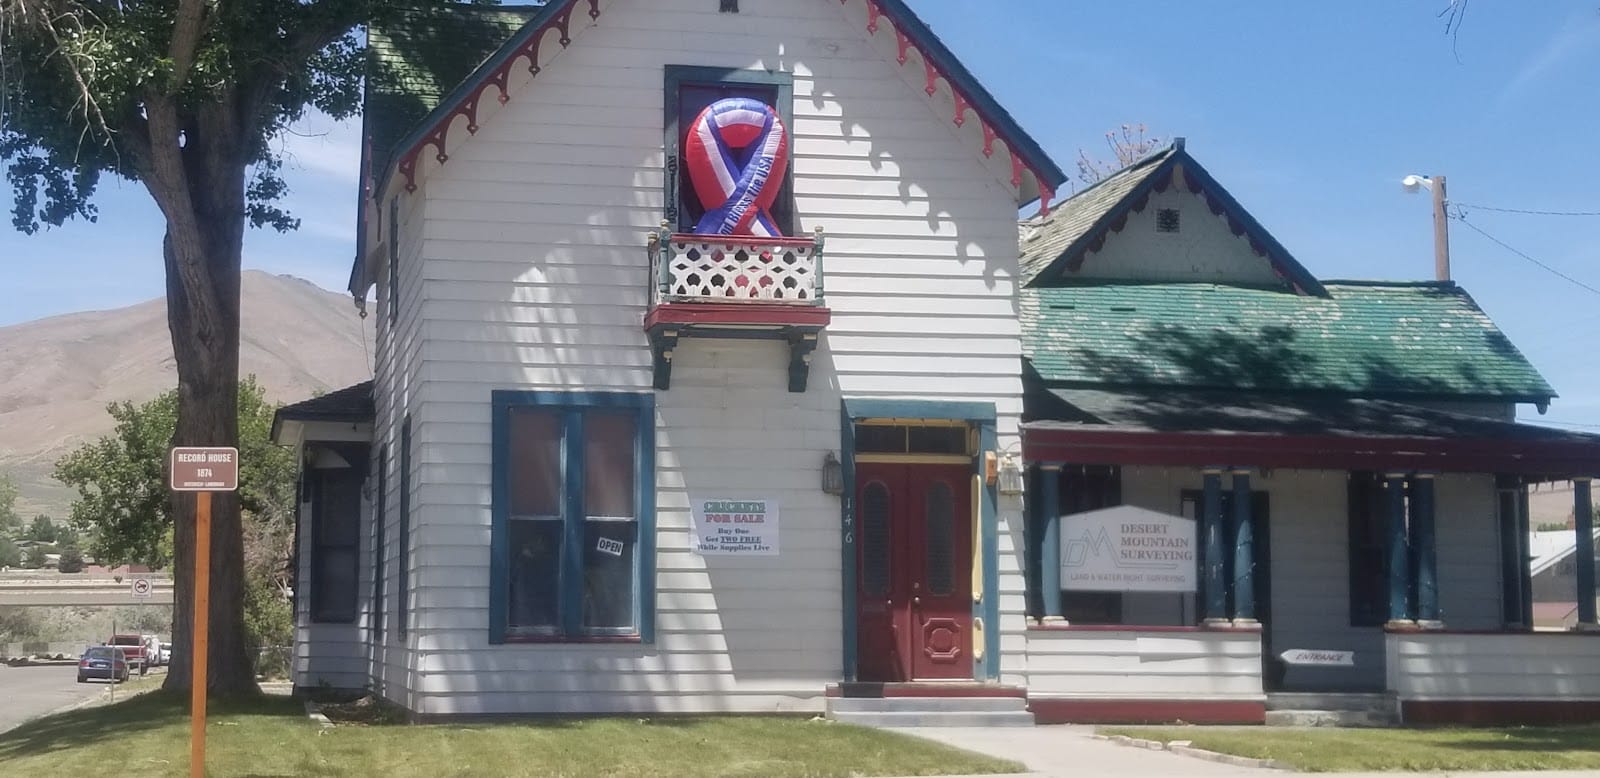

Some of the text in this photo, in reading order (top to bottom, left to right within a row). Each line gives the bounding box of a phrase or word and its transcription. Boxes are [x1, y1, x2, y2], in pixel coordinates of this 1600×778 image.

[726, 197, 753, 222] Bless
[747, 178, 764, 198] the
[757, 156, 774, 179] USA
[178, 453, 232, 463] RECORD HOUSE
[705, 514, 765, 523] FOR SALE
[718, 527, 732, 535] Buy
[1120, 523, 1169, 534] DESERT
[600, 539, 621, 553] OPEN
[720, 544, 752, 552] Supplies
[1120, 537, 1190, 548] MOUNTAIN
[1120, 550, 1193, 561] SURVEYING
